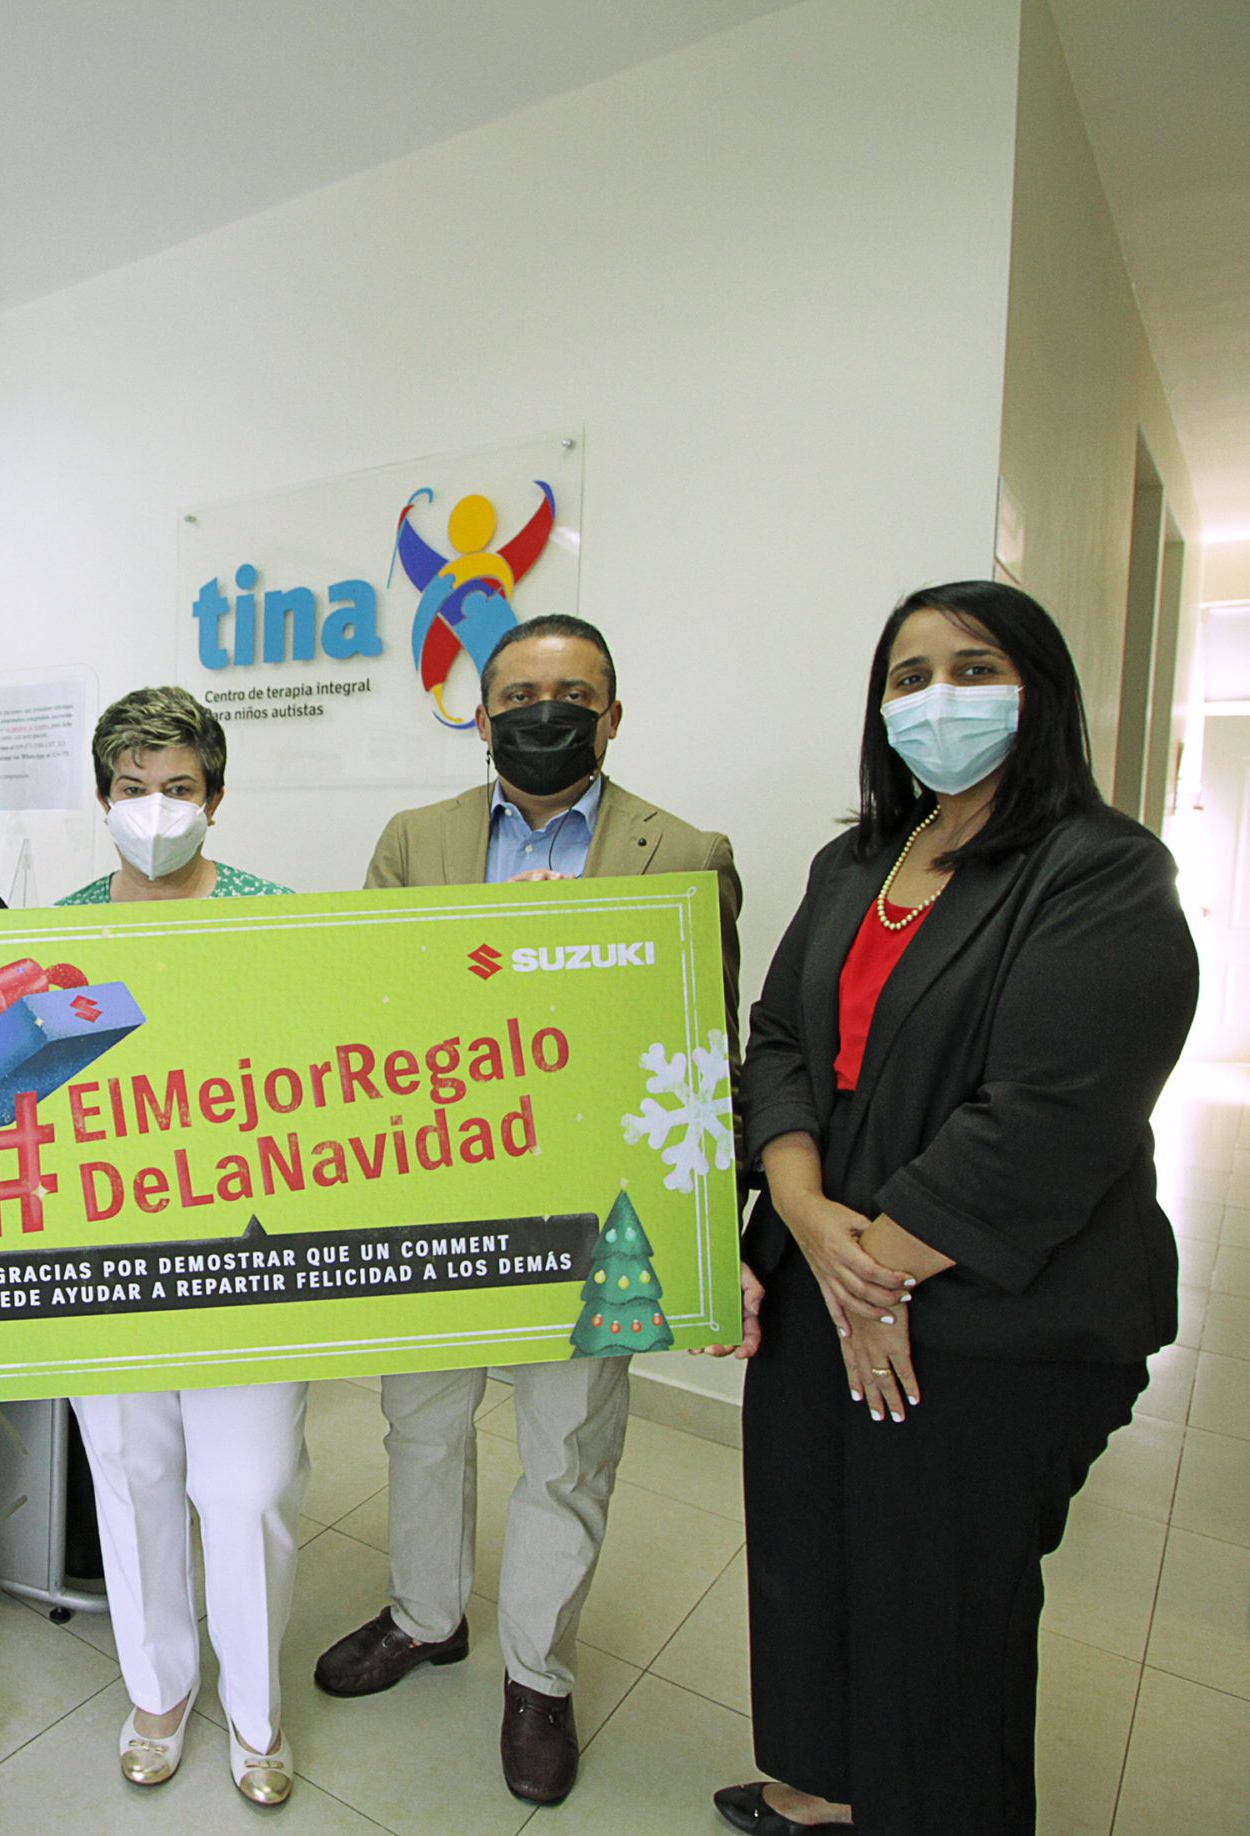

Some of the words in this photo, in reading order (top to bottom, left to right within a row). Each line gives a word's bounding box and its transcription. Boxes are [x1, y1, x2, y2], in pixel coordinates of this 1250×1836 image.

[192, 563, 382, 670] tina
[205, 689, 245, 703] Centro
[248, 687, 264, 700] de
[267, 683, 312, 699] terapia
[317, 678, 371, 696] integral
[235, 706, 268, 719] niños
[272, 704, 323, 718] autistas
[511, 941, 655, 972] SUZUKI
[79, 1095, 538, 1223] DeLaNavidad
[52, 1281, 142, 1305] AYUDAR
[152, 1280, 166, 1299] A
[177, 1271, 286, 1297] REPARTIR
[297, 1264, 412, 1289] FELICIDAD
[423, 1264, 438, 1281] A
[448, 1260, 488, 1279] LOS
[499, 1251, 573, 1275] DEMÁS
[104, 1259, 148, 1278] POR
[159, 1249, 296, 1274] DEMOSTRAR
[306, 1246, 350, 1265] QUE
[361, 1243, 390, 1261] UN
[401, 1235, 510, 1258] COMMENT
